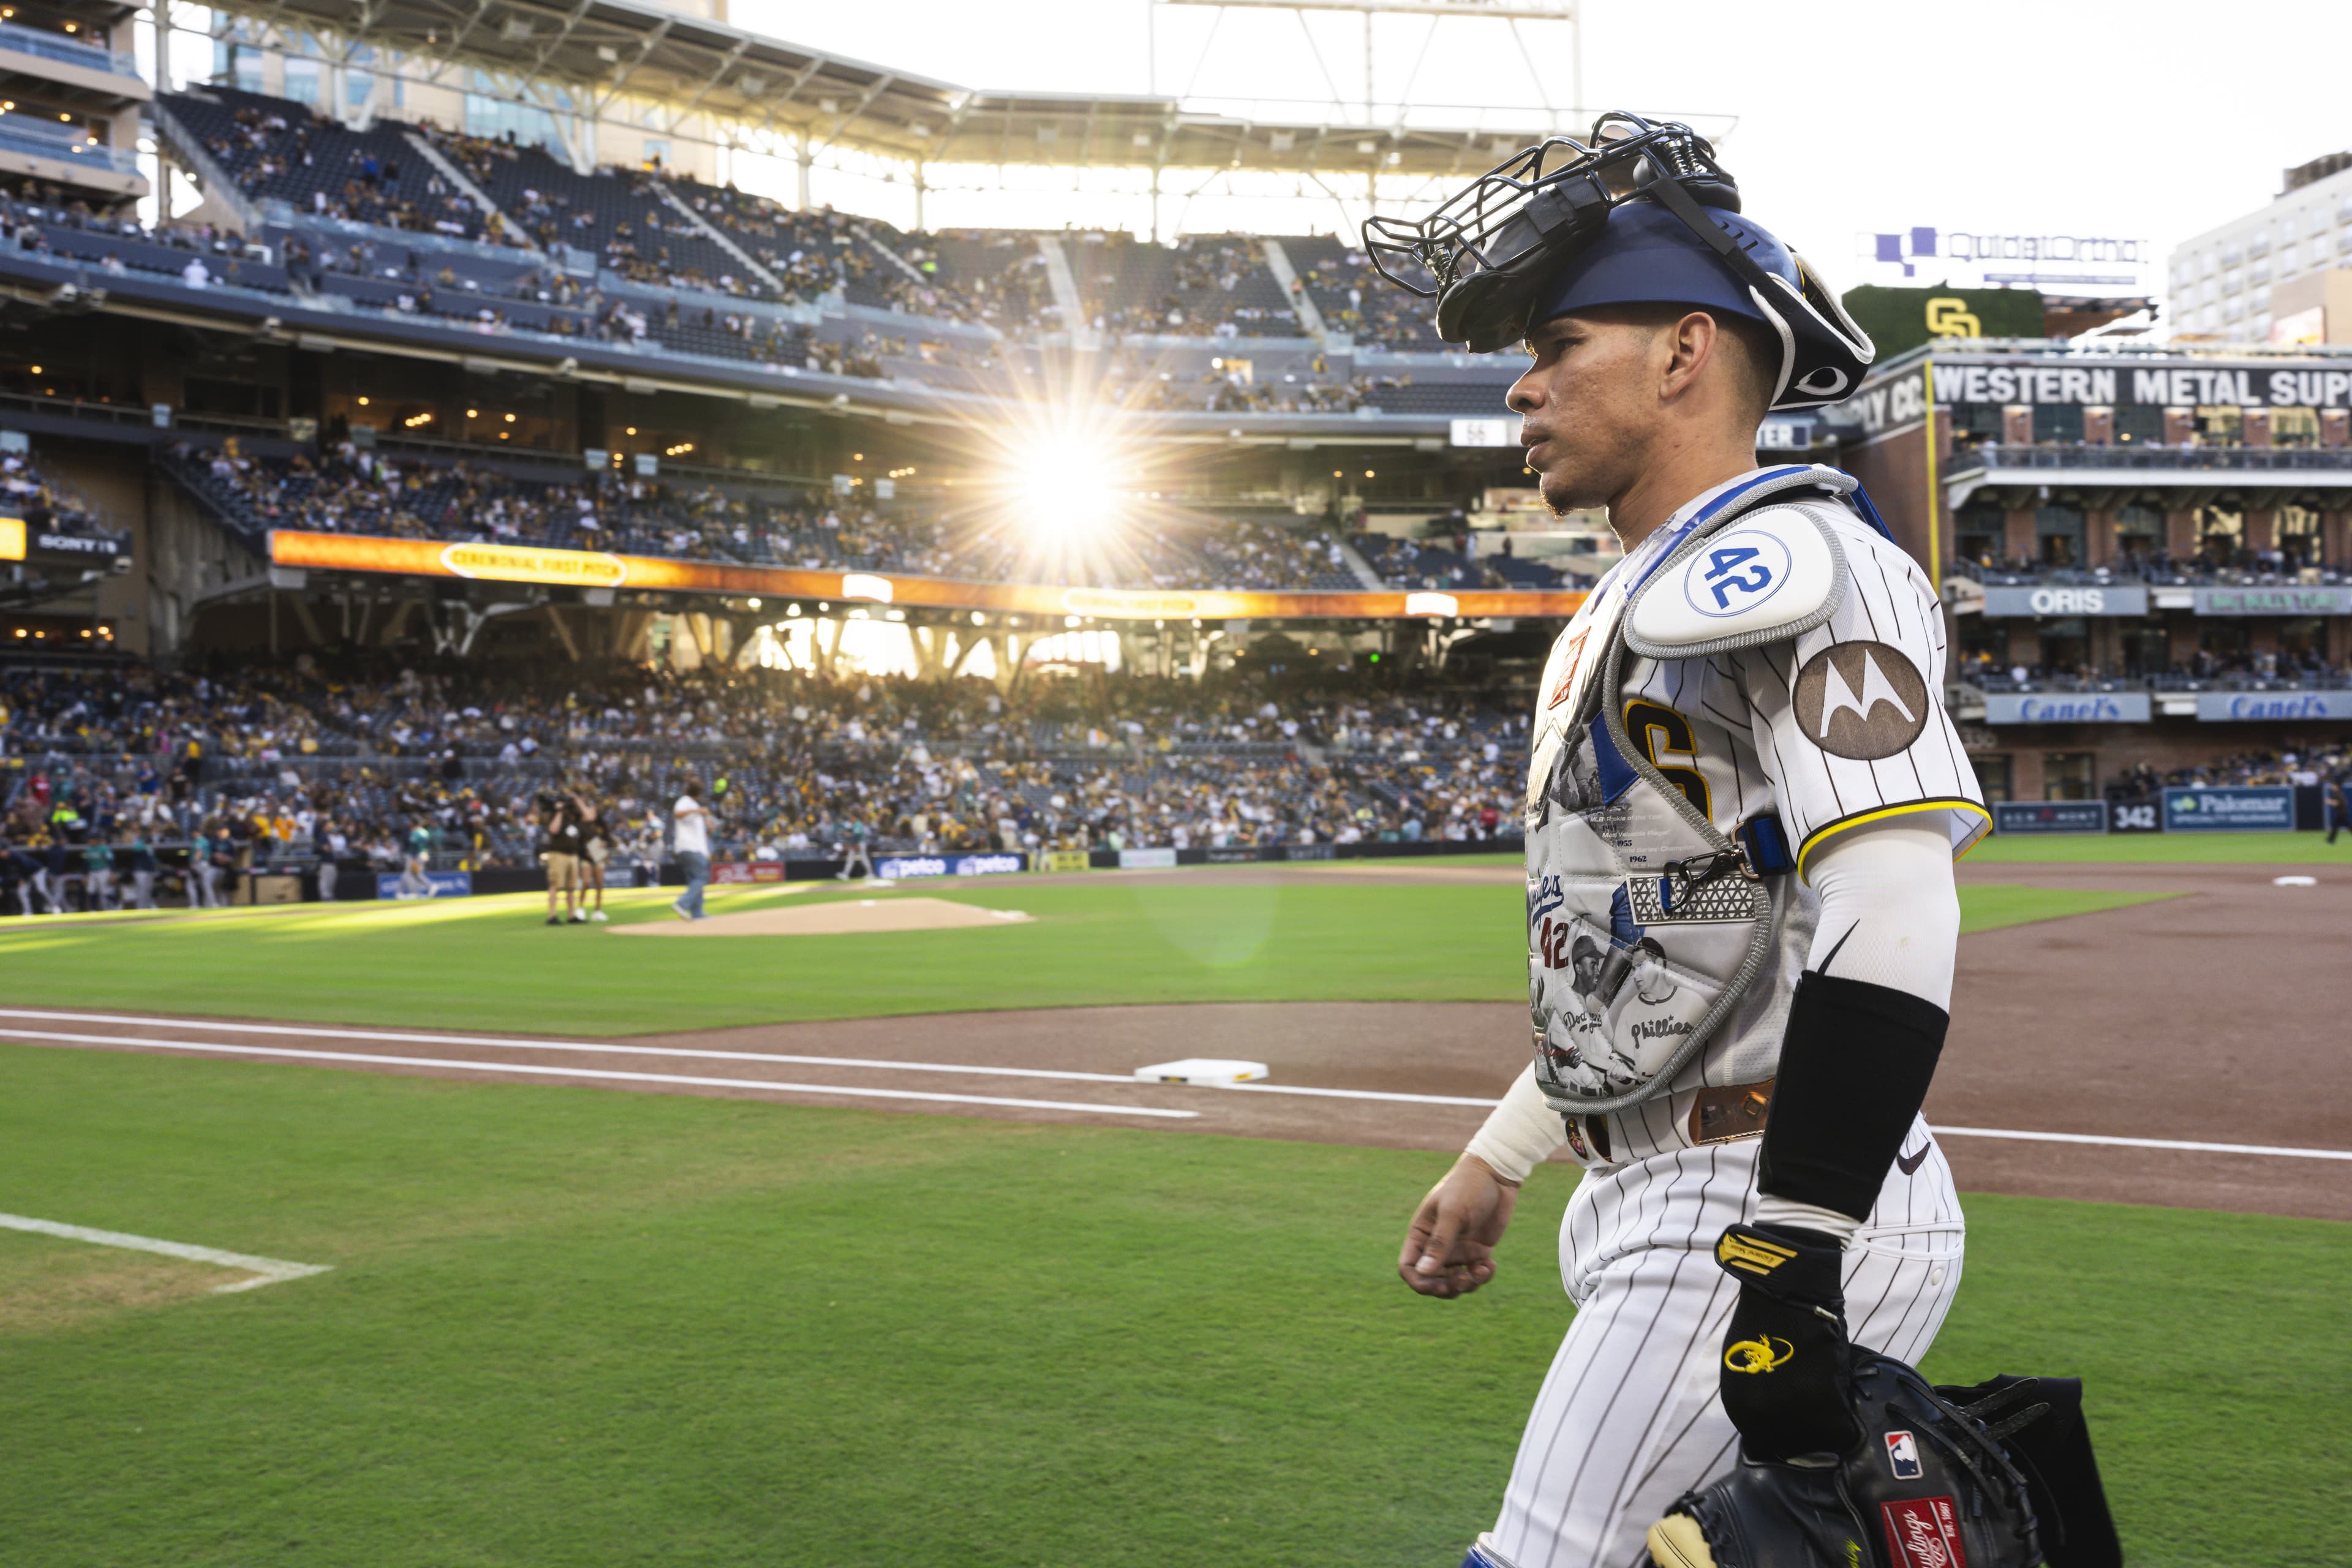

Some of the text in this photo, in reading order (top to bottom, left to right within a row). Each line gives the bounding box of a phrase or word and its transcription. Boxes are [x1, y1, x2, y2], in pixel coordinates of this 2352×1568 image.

[1932, 366, 2352, 407] WESTERN METAL SUP
[1705, 548, 1772, 609] 42
[2031, 589, 2104, 612] ORIS
[2021, 698, 2120, 721] Canel's
[2231, 696, 2327, 720] Canel's
[2199, 794, 2286, 813] Palomar
[2115, 805, 2155, 828] 342
[900, 854, 1020, 877] petco petco
[1540, 916, 1570, 970] 42
